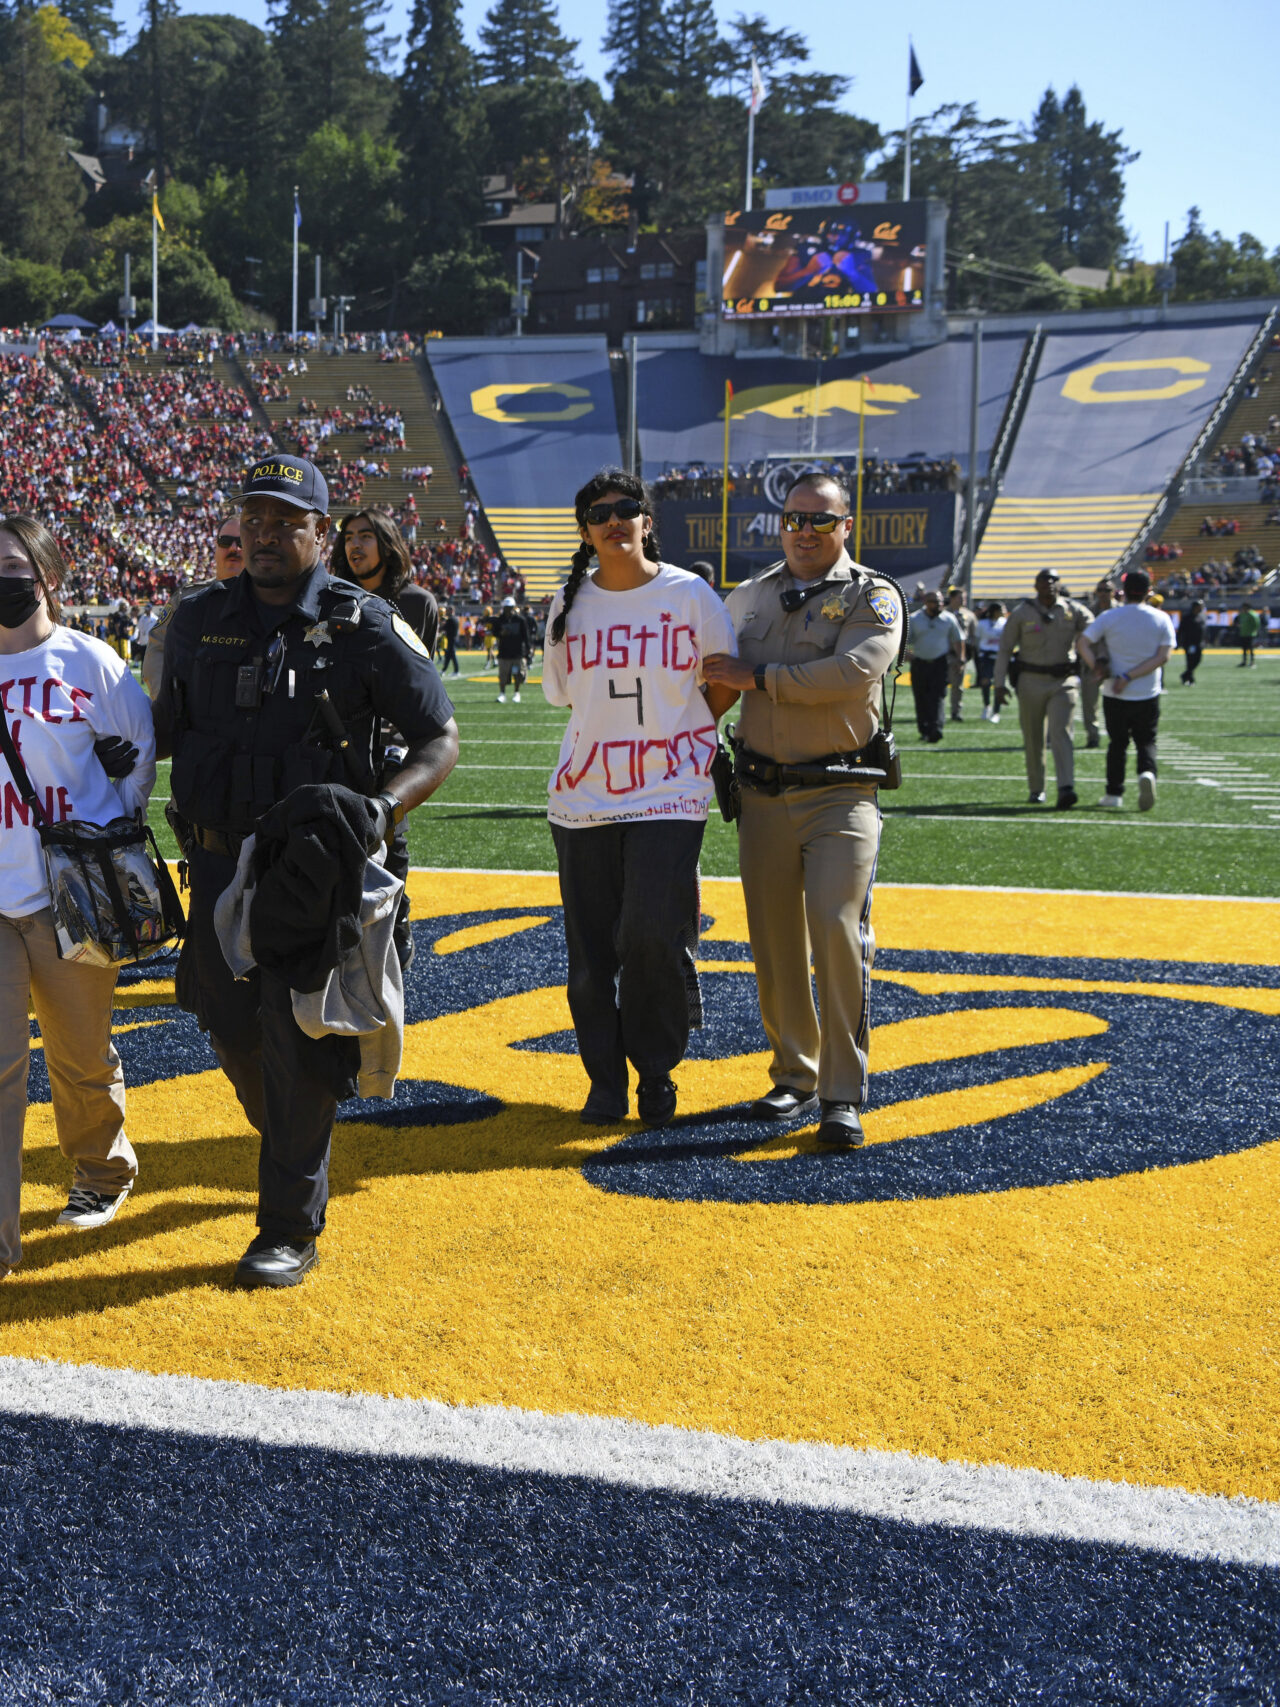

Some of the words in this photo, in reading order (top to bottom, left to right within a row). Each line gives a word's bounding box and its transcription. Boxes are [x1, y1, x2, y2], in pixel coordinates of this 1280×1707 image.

[791, 189, 833, 204] BMO
[252, 464, 304, 482] POLICE
[686, 518, 724, 548] THIS
[608, 676, 644, 726] 4
